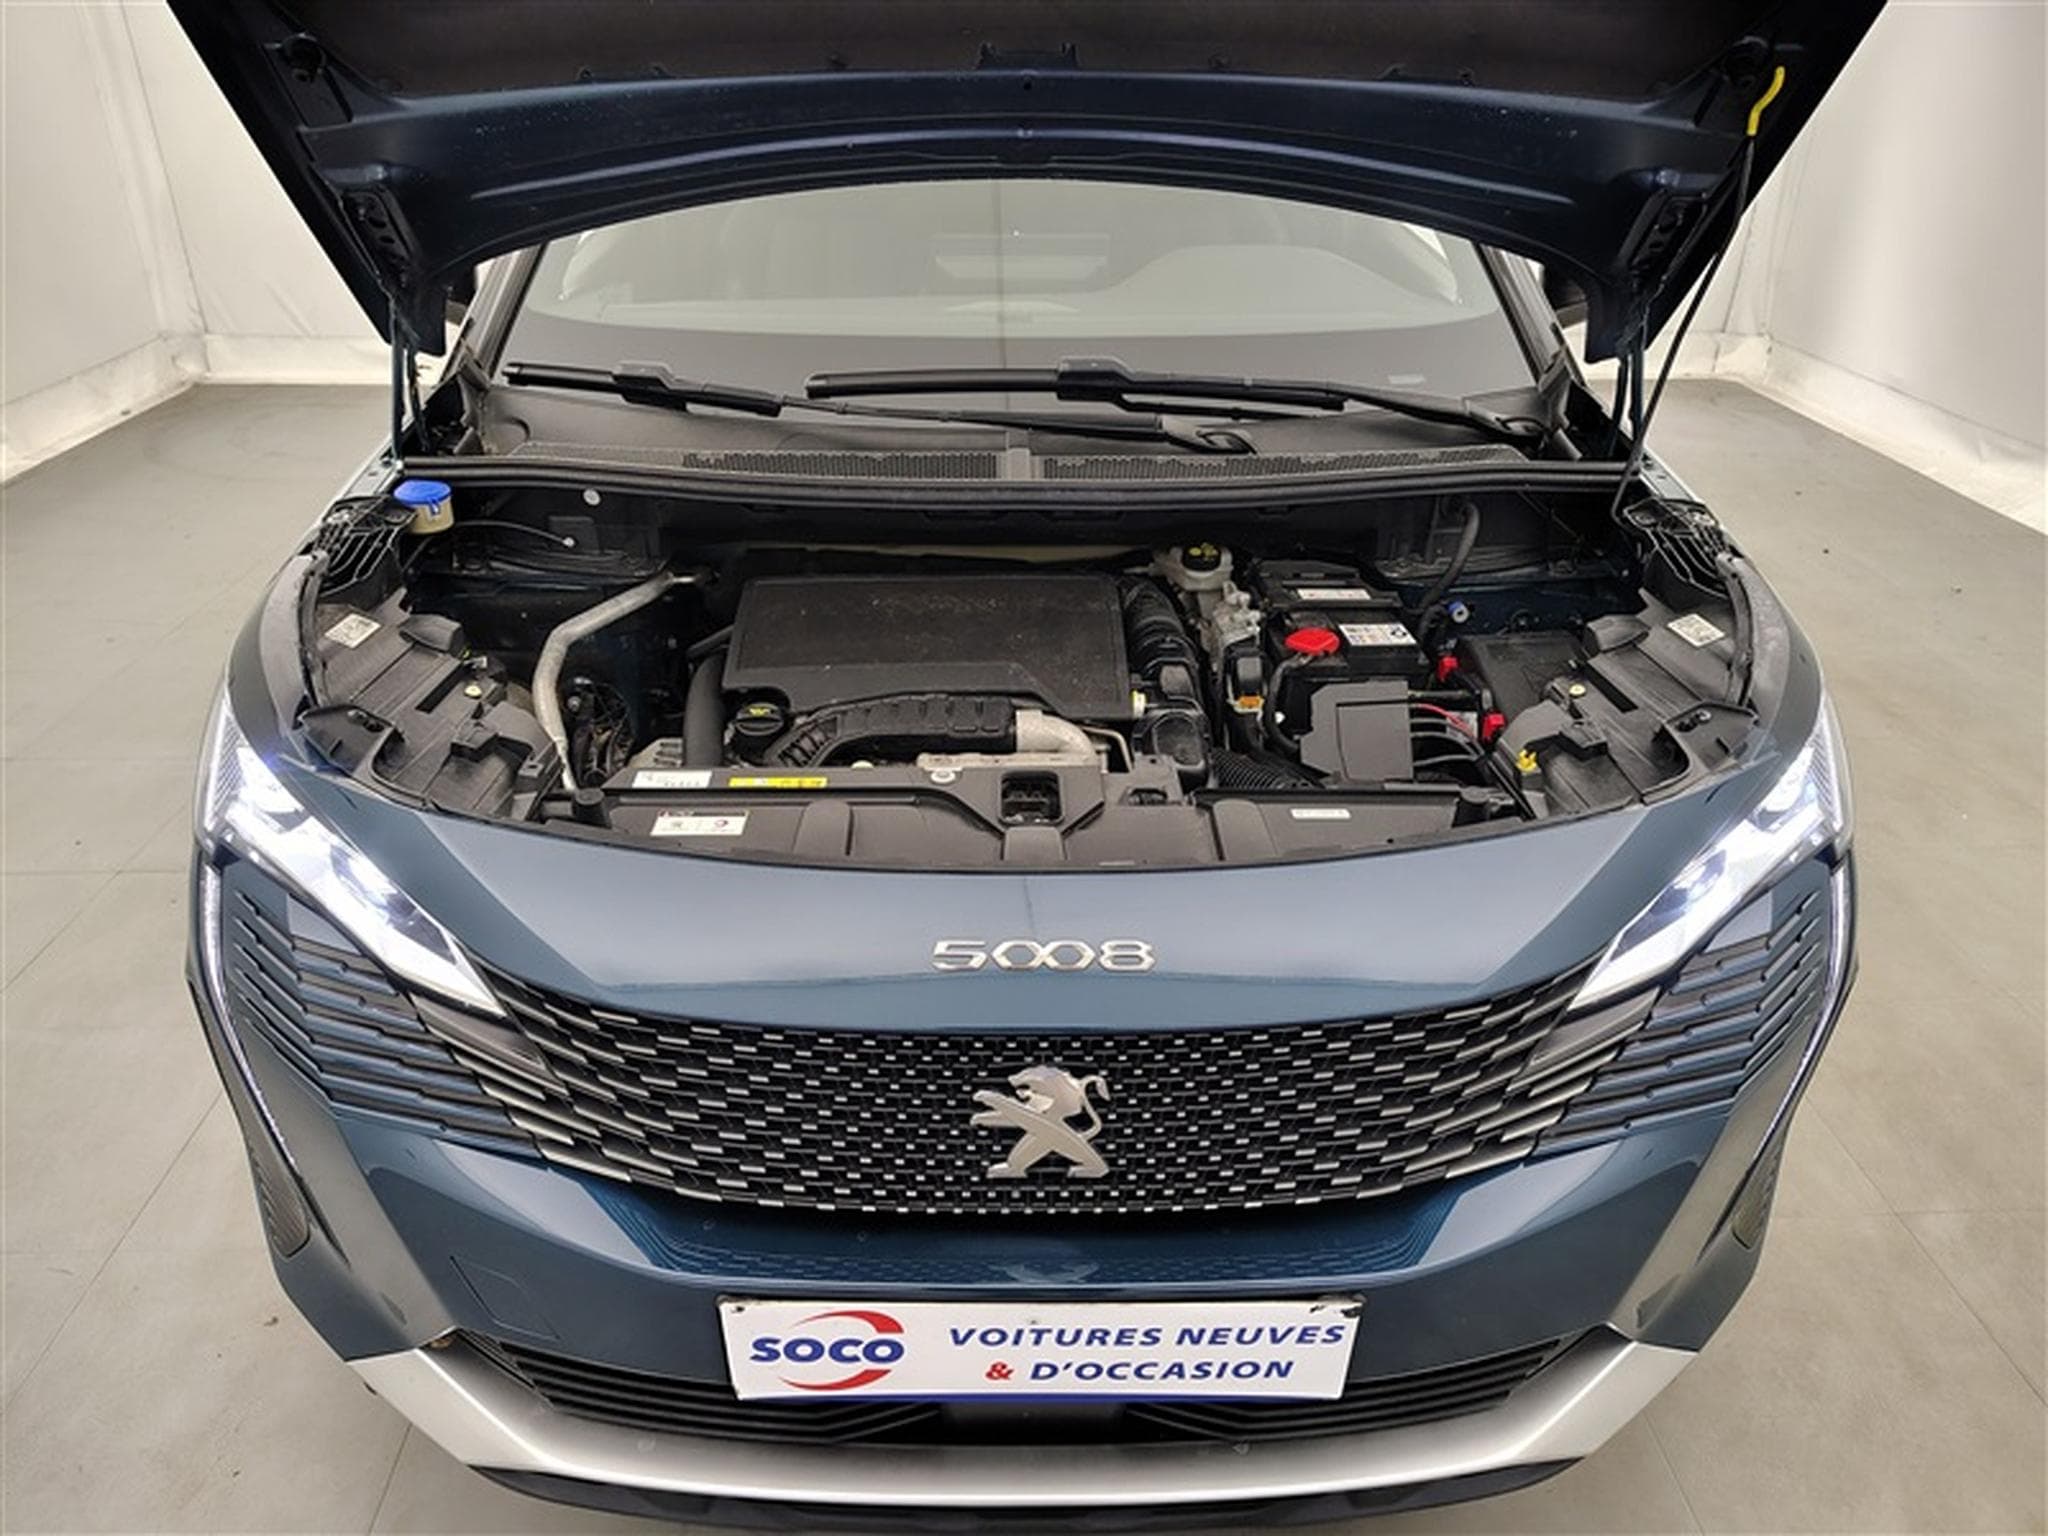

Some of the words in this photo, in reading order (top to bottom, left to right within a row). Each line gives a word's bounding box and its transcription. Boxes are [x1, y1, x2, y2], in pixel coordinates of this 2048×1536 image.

[931, 940, 1156, 972] 5008
[949, 1327, 1164, 1347] VOITURES
[1175, 1325, 1347, 1346] NEUVES
[750, 1337, 905, 1364] SOCO
[985, 1361, 1014, 1381] &
[1029, 1360, 1295, 1381] D'OCCASION
